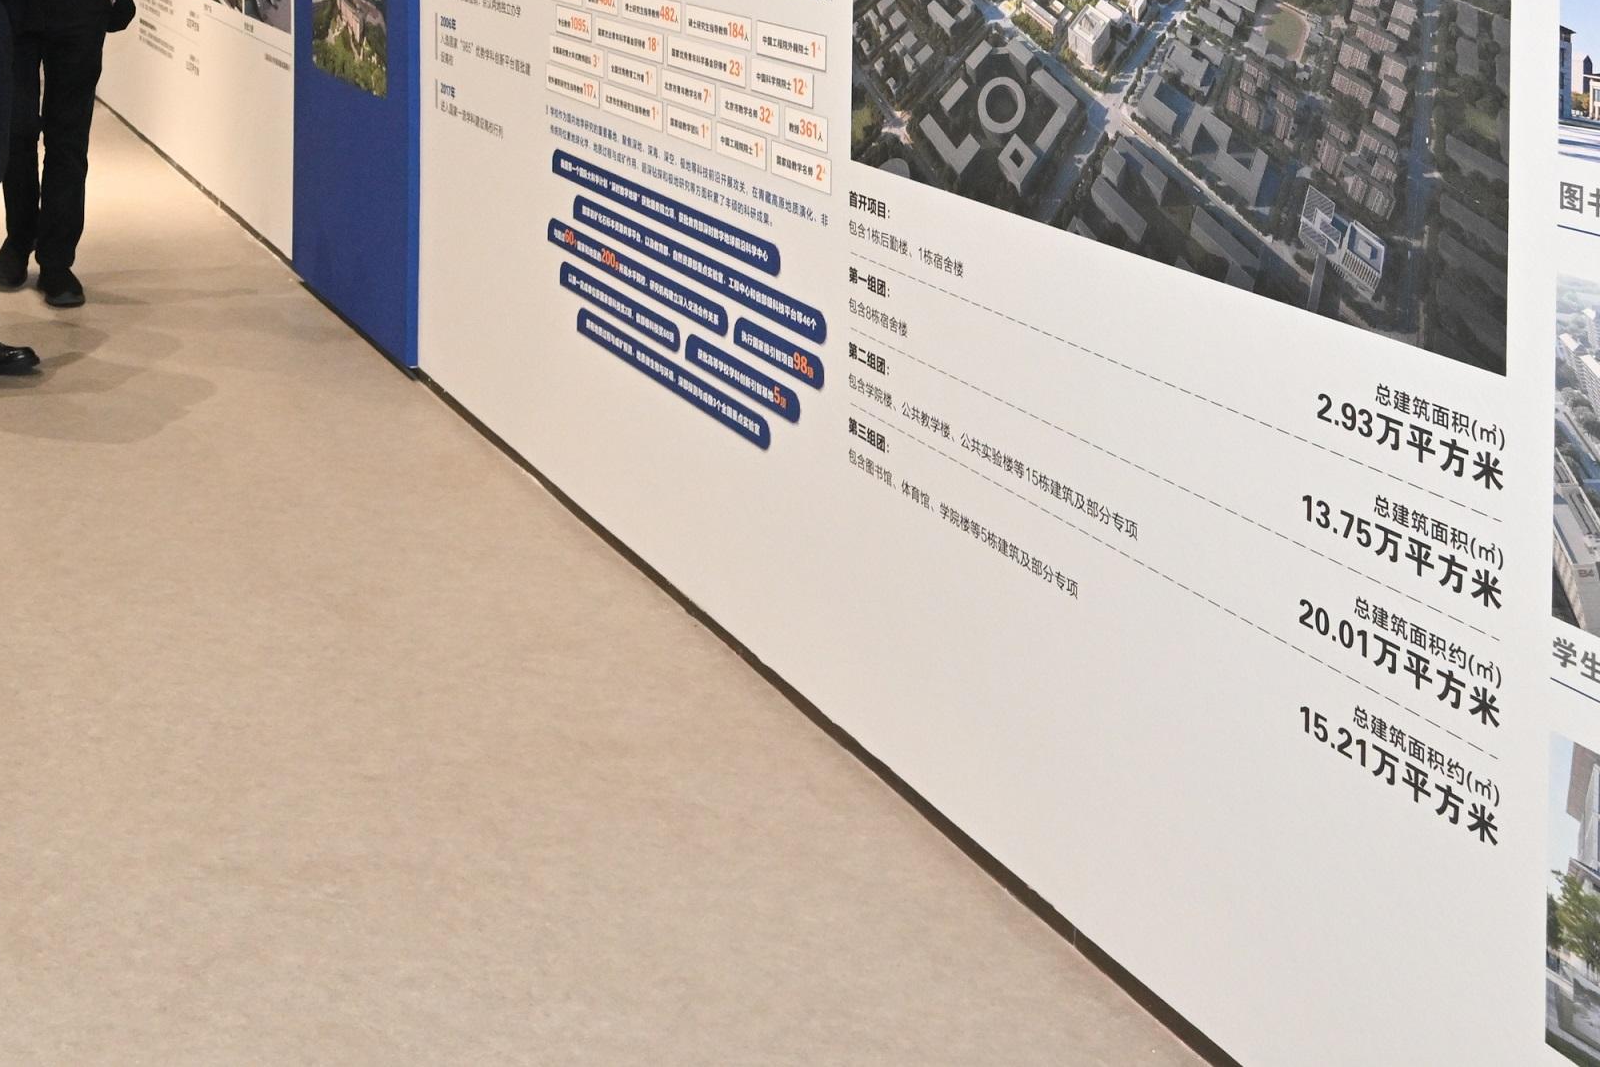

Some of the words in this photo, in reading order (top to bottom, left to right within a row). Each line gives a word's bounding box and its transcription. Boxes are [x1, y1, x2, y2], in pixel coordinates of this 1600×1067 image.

[849, 190, 891, 220] 首开项目：
[849, 220, 964, 278] 包含1栋后勤楼、1栋宿舍楼
[849, 266, 891, 298] 第一组团：
[849, 297, 908, 338] 包含8栋宿舍楼
[849, 342, 890, 376] 第二组团：
[849, 418, 890, 453] 第三组团：
[849, 372, 1139, 541] 包含学院楼、公共教学楼、公共实验楼等15栋建筑及部分专项
[1317, 393, 1503, 491] 2.93万平方米
[849, 448, 1079, 599] 包含图书馆、体育馆、学院楼等5栋建筑及部分专项
[1302, 494, 1501, 610] 13.75万平方米
[1299, 599, 1500, 728] 20.01万平方米
[1299, 705, 1498, 846] 15.21万平方米
